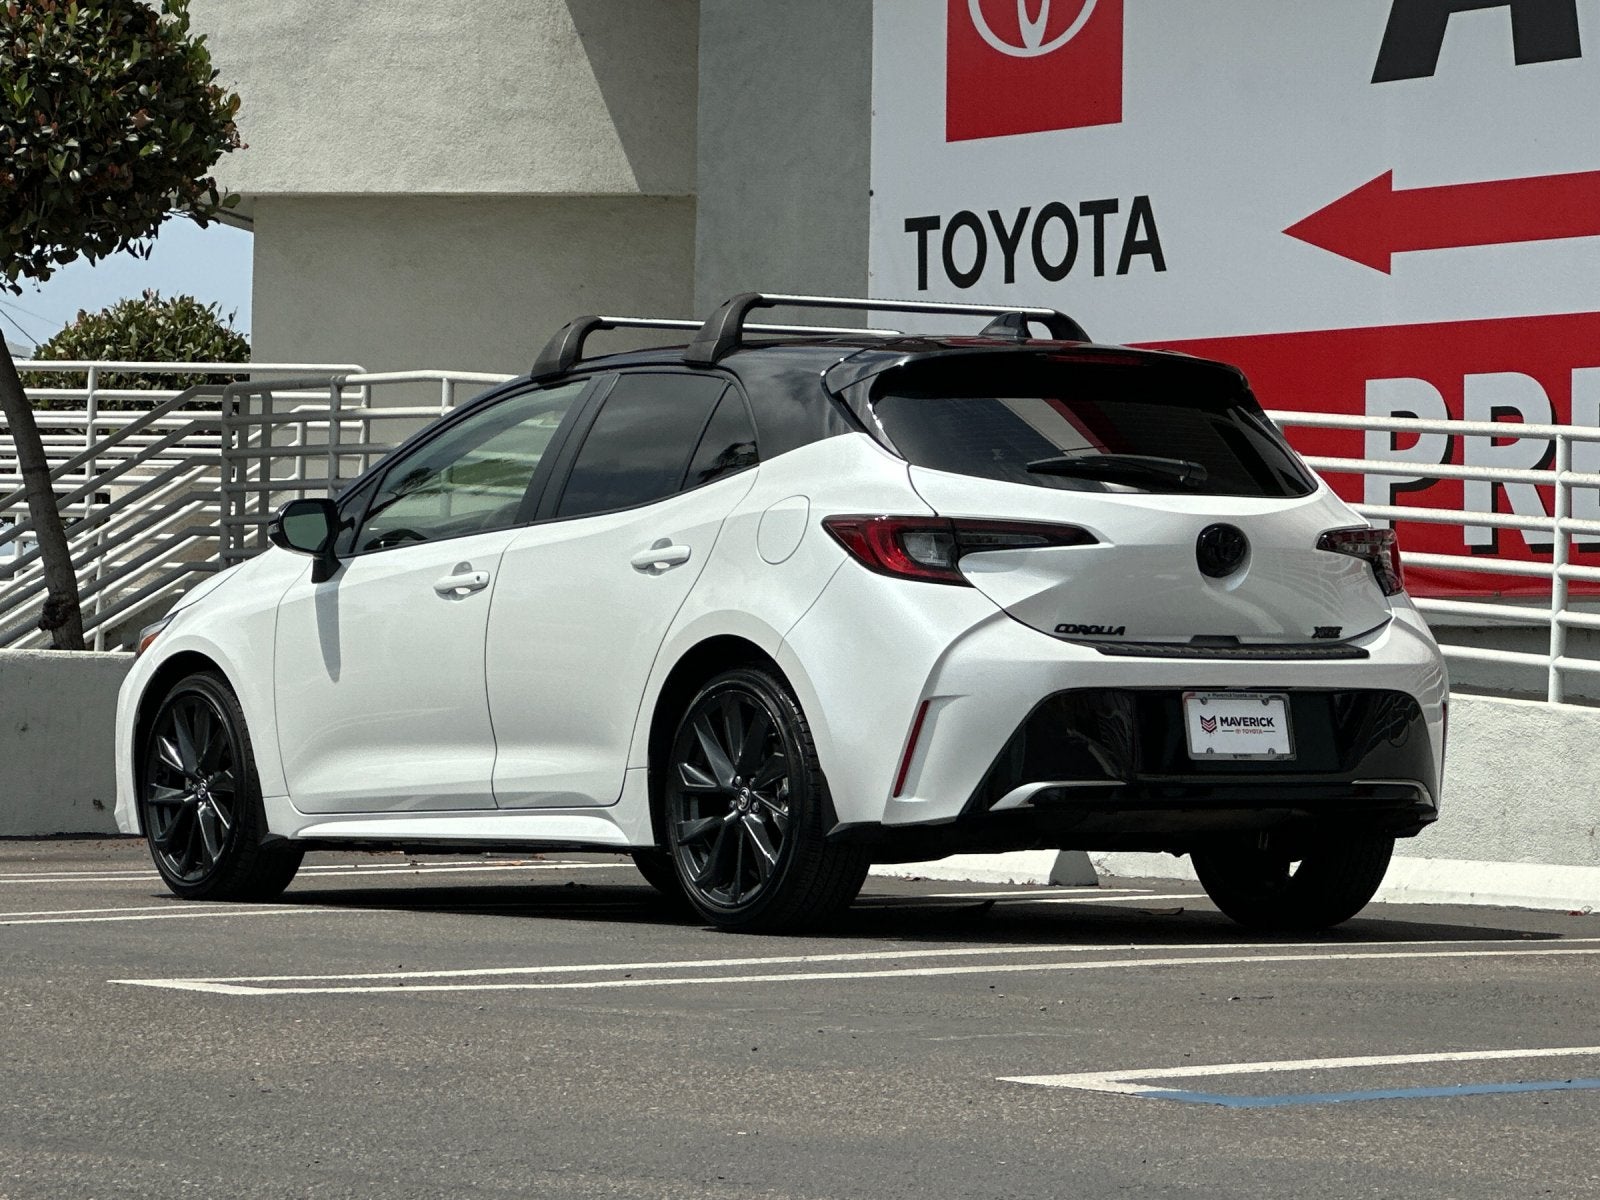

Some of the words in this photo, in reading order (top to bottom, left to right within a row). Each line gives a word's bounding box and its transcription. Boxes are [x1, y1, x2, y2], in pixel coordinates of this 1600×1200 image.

[904, 195, 1167, 291] TOYOTA
[1054, 623, 1126, 636] COROLLA
[1219, 716, 1275, 727] MAVERICK
